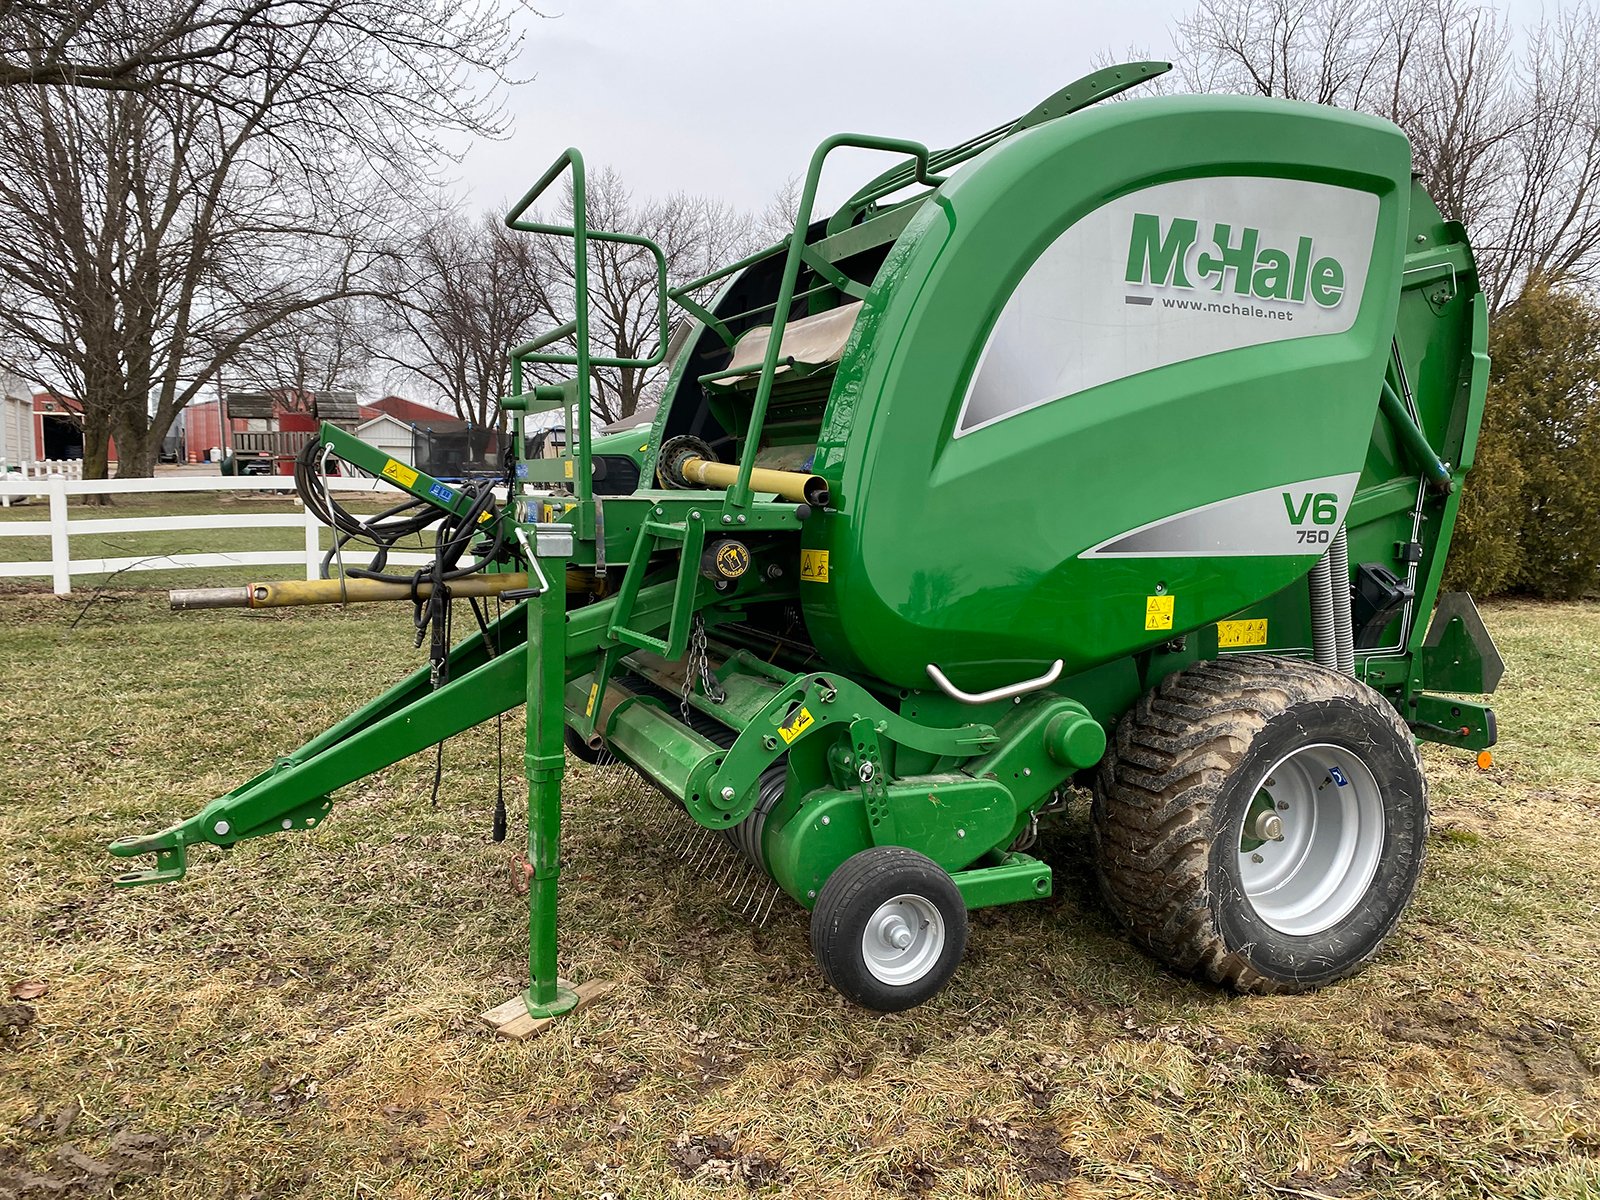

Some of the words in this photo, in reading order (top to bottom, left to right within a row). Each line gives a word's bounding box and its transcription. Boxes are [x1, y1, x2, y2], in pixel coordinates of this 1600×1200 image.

[1125, 213, 1345, 308] McHale
[1162, 298, 1294, 322] www.mchale.net
[1282, 492, 1338, 526] V6
[1296, 530, 1329, 543] 750
